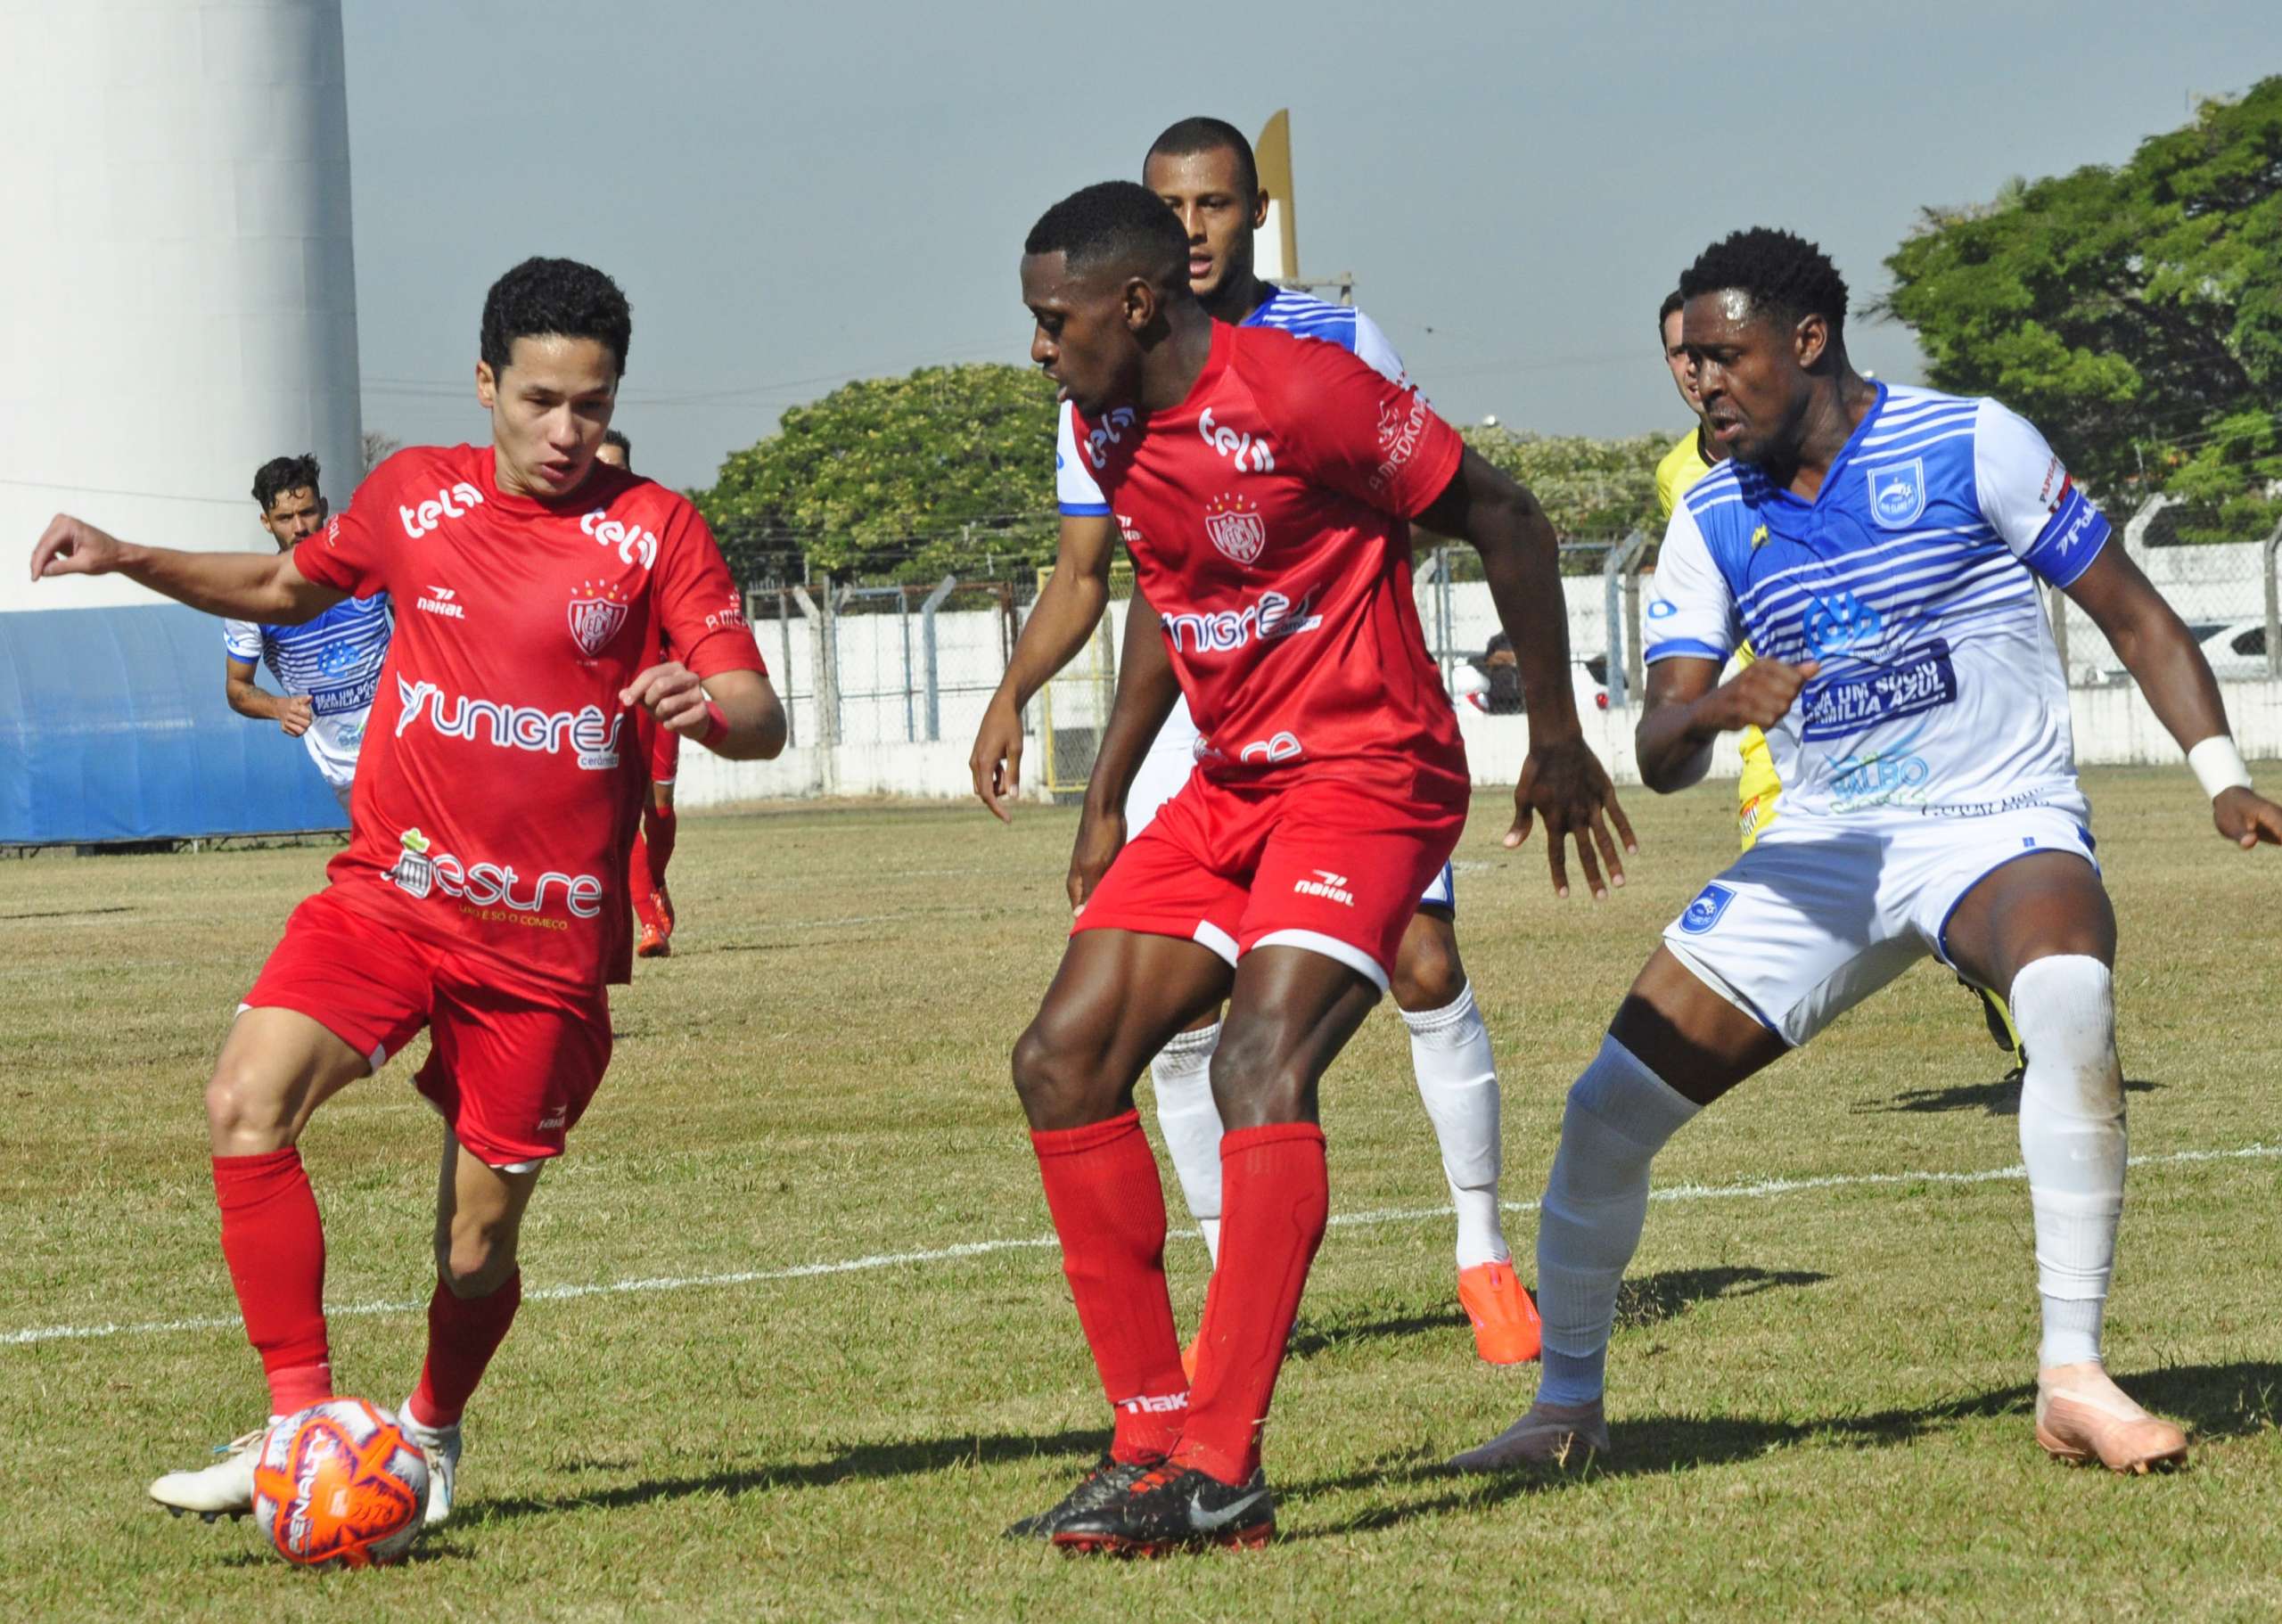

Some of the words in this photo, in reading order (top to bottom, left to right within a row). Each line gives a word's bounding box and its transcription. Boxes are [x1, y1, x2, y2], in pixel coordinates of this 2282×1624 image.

[1838, 682, 1869, 702] UM
[1889, 672, 1946, 709] AZUL
[432, 853, 603, 919] estre
